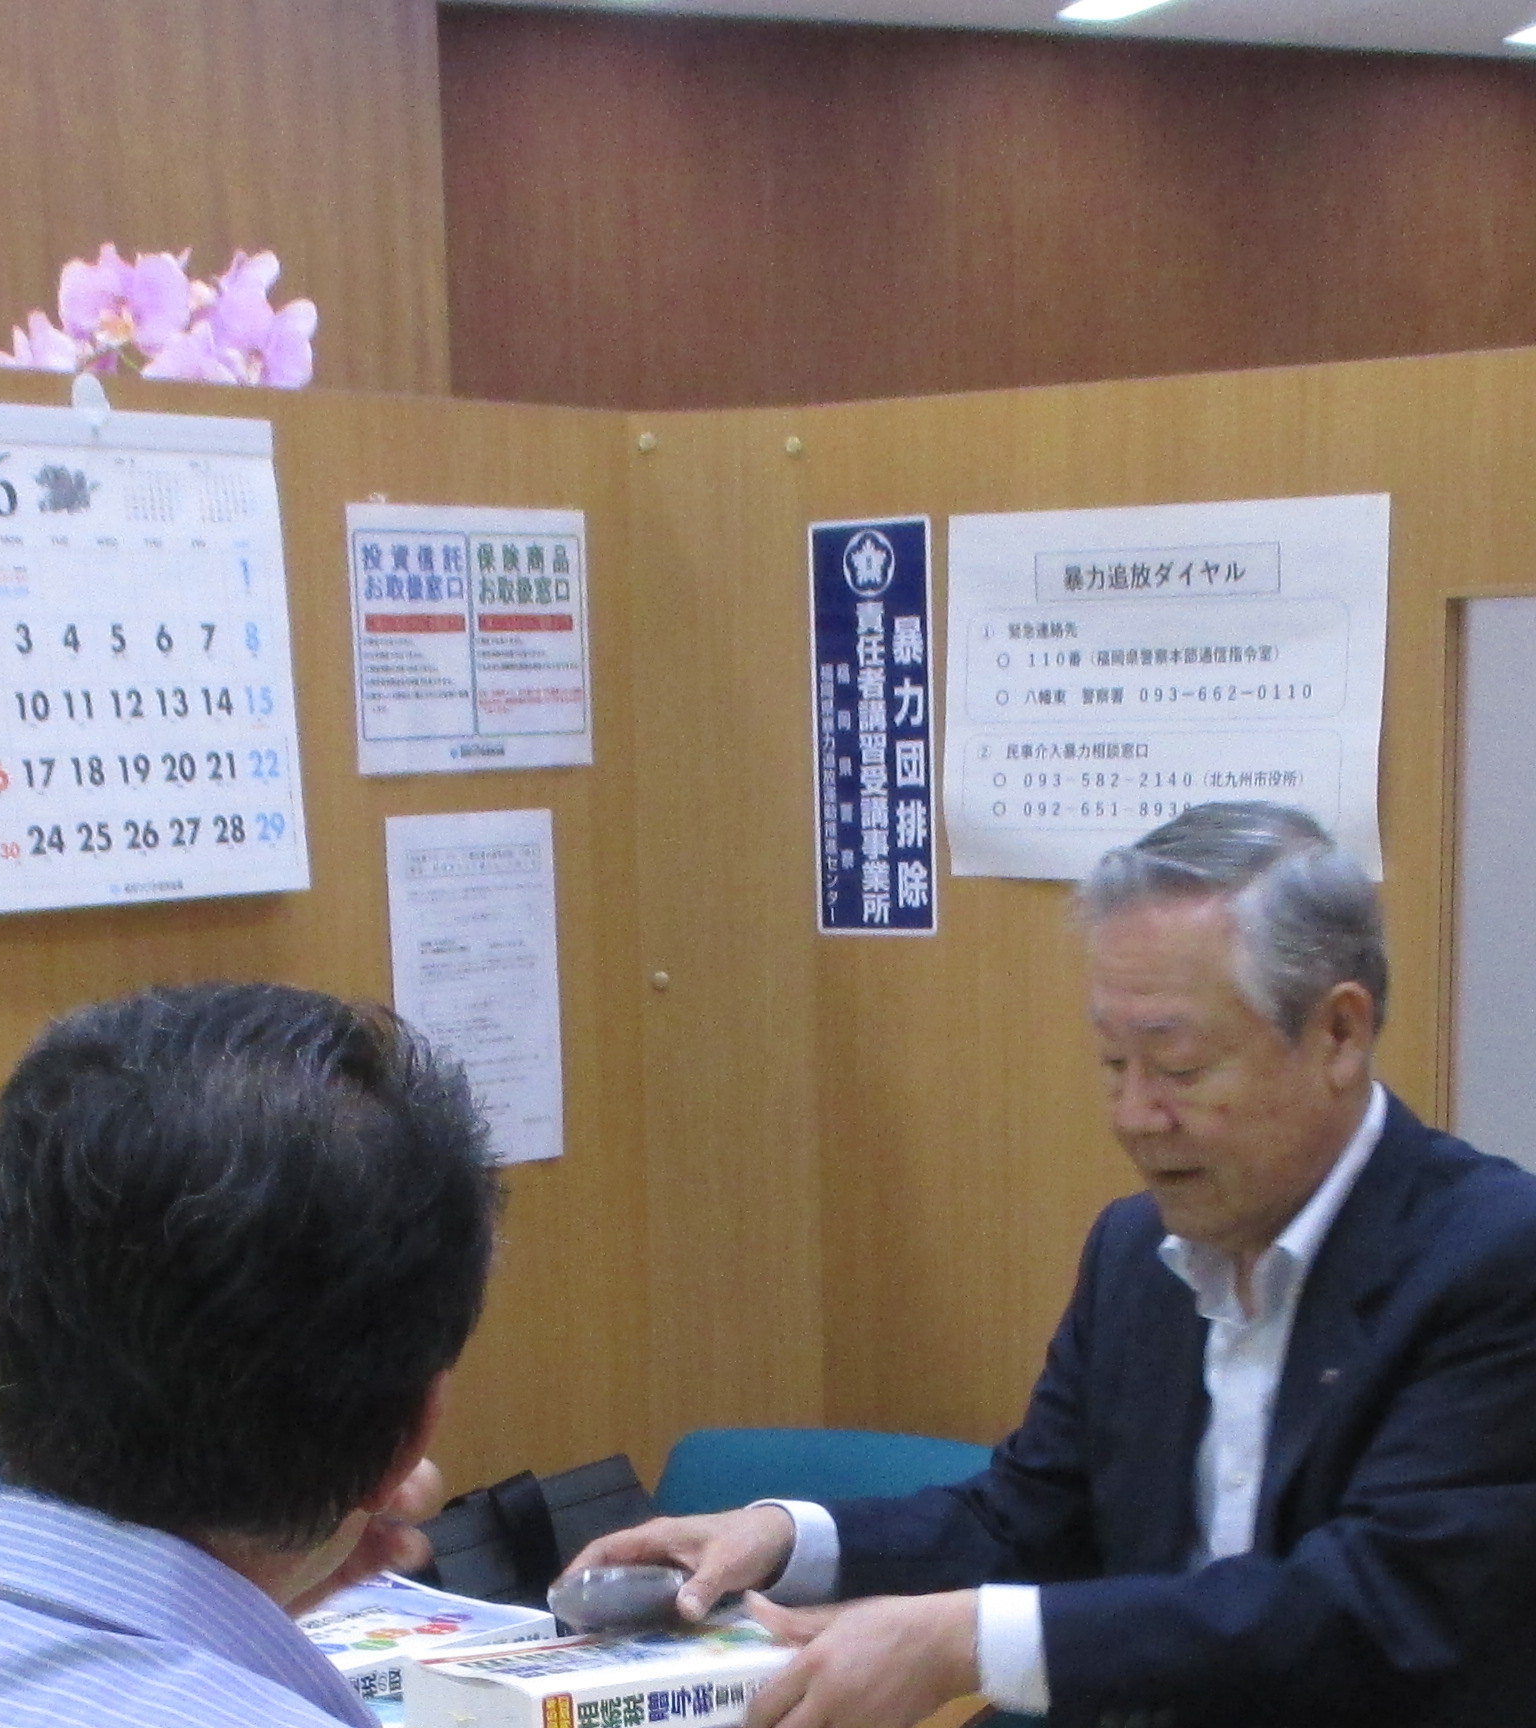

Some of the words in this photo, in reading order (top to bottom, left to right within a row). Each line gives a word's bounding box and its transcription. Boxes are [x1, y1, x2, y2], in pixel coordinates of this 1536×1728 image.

[240, 559, 250, 586] 1
[1064, 560, 1246, 592] 暴力追放ダイヤル
[16, 623, 33, 654] 3
[63, 624, 80, 652] 4
[112, 624, 126, 654] 5
[156, 624, 173, 653] 6
[201, 623, 215, 651] 7
[245, 622, 260, 651] 8
[16, 691, 49, 721] 10
[64, 690, 93, 719] 11
[111, 688, 143, 718] 12
[156, 688, 188, 717] 13
[202, 688, 233, 715] 14
[246, 687, 273, 715] 15
[1139, 683, 1313, 702] 093-662-0110
[23, 758, 55, 787] 17
[71, 756, 104, 786] 18
[119, 754, 150, 784] 19
[162, 753, 196, 782] 20
[207, 751, 235, 780] 21
[249, 750, 279, 777] 22
[855, 601, 891, 925] 責任者講習受講事業所
[892, 615, 930, 909] 暴力団排除
[1, 842, 20, 859] 30
[28, 826, 64, 855] 24
[77, 823, 112, 852] 25
[125, 820, 159, 849] 26
[170, 817, 200, 846] 27
[213, 815, 245, 843] 28
[256, 813, 285, 840] 29
